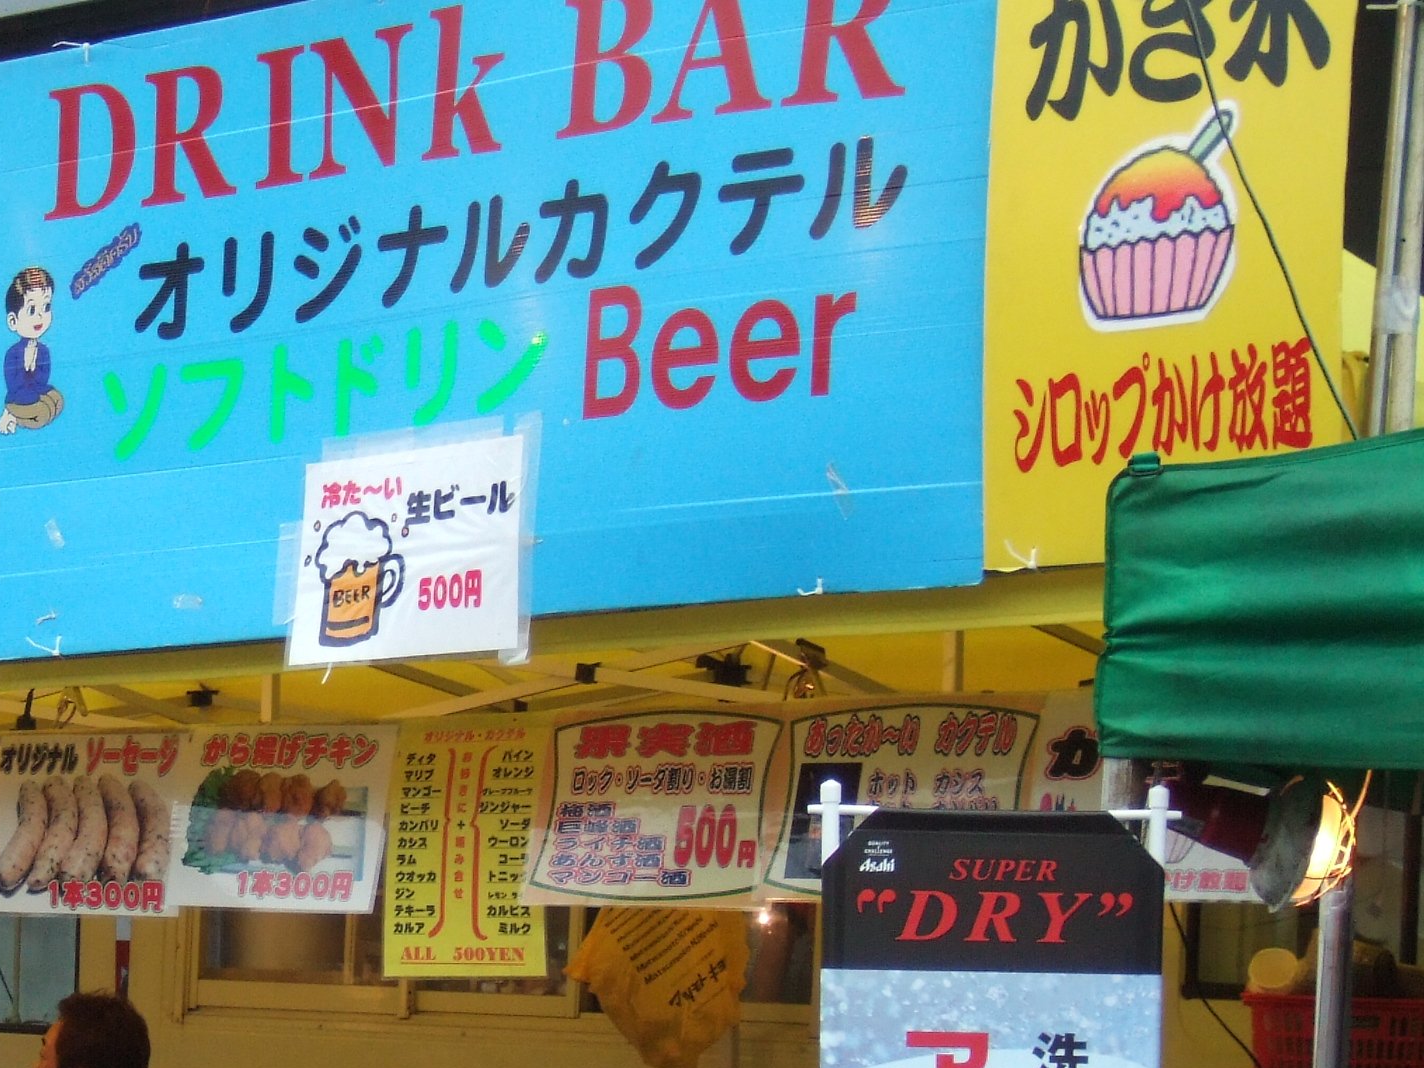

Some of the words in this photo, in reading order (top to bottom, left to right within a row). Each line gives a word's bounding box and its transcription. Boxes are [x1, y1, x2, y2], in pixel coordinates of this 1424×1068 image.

[556, 0, 907, 139] BAR
[132, 136, 907, 340] オリジナルカクテル
[582, 285, 856, 420] Beer
[1013, 336, 1314, 473] シロップかけ放題
[405, 481, 515, 525] 生ビール
[333, 586, 371, 608] BEER
[418, 569, 482, 610] 500円
[574, 720, 758, 759] 果実酒
[934, 711, 1018, 756] カクテル
[0, 743, 78, 774] オリジナル
[86, 735, 178, 777] ソーセージ
[200, 731, 378, 769] から揚げチキン
[492, 767, 534, 779] オレンジ
[402, 787, 442, 798] マンゴー
[479, 803, 532, 814] ジンジャー
[397, 837, 428, 848] カシス
[553, 835, 668, 852] ライチ酒
[673, 803, 758, 869] 500円
[396, 854, 417, 865] ラム
[859, 858, 896, 873] Asahi
[949, 859, 1058, 881] SUPER
[236, 870, 354, 901] 1本300円
[547, 869, 692, 887] マンゴー酒
[47, 879, 166, 912] 1本300円
[395, 888, 415, 899] ジン
[394, 905, 436, 916] テキーラ
[393, 922, 425, 934] カルア
[498, 922, 531, 934] ミルク
[401, 947, 436, 961] ALL
[453, 946, 525, 962] 500YEN
